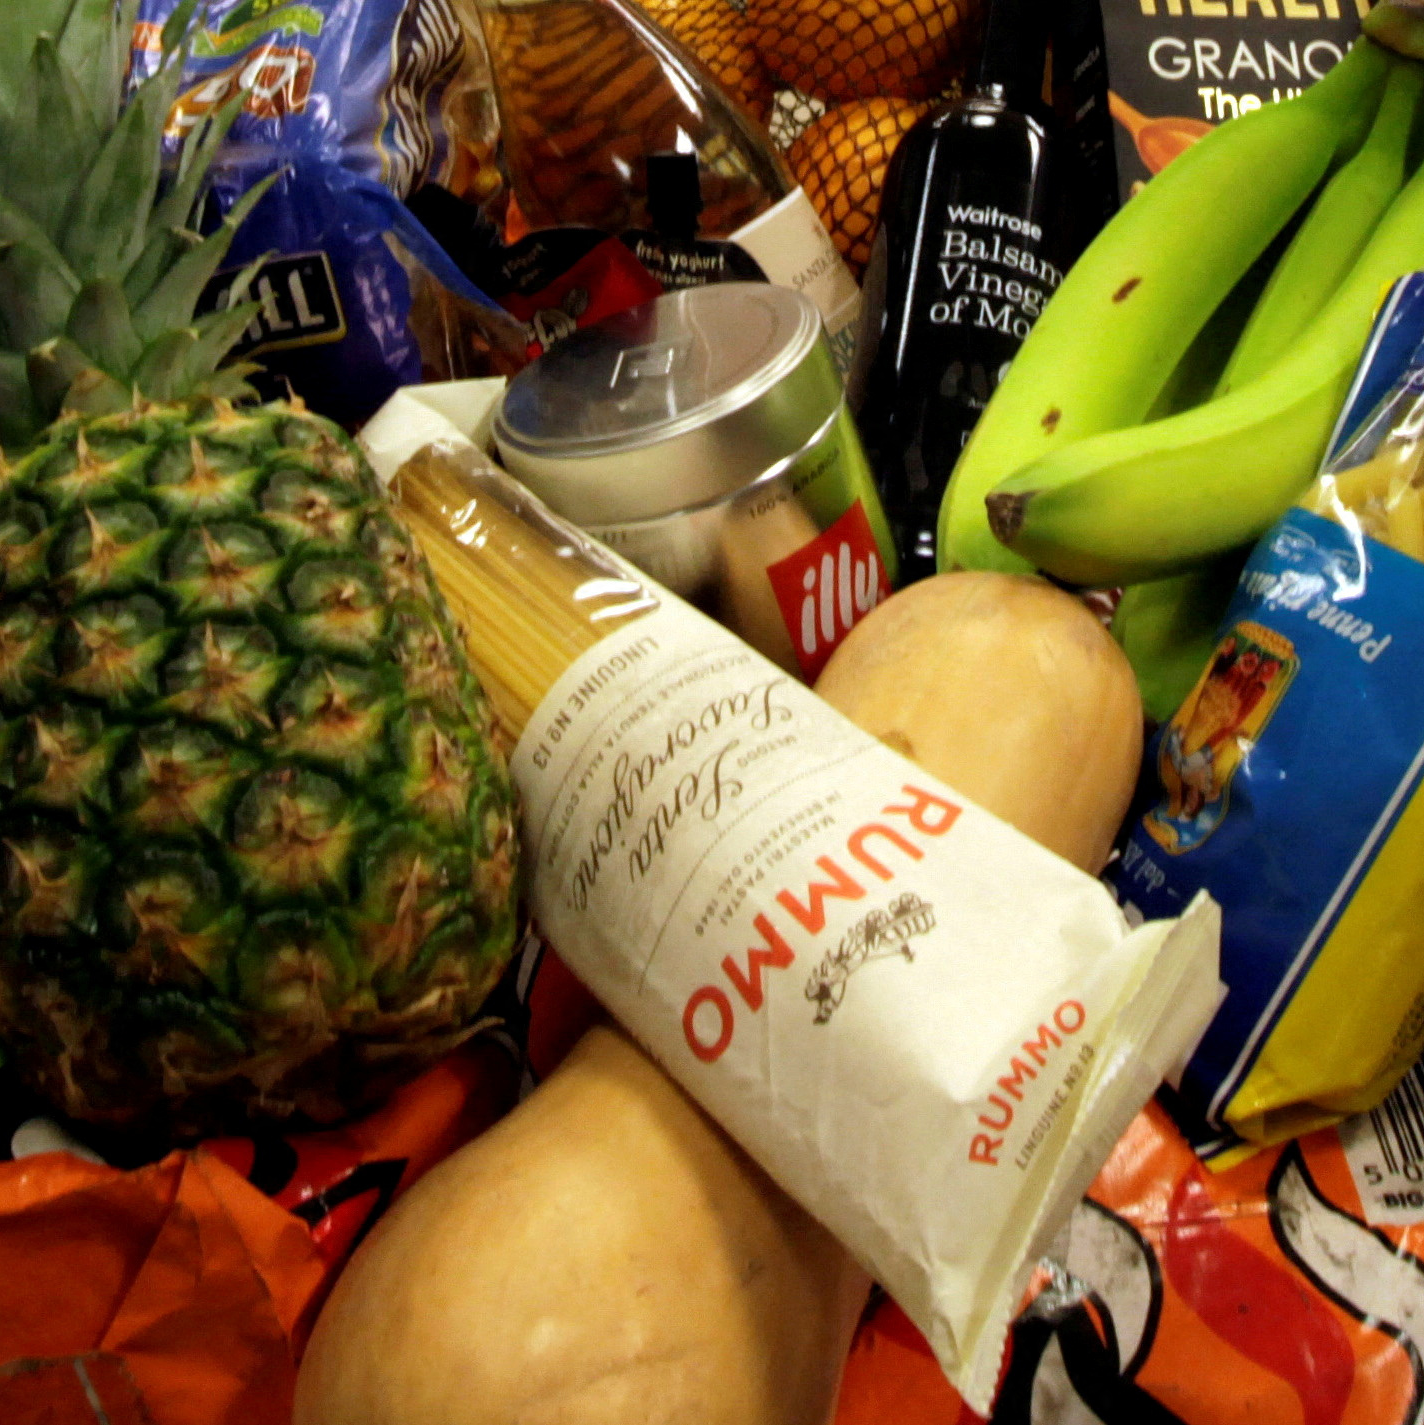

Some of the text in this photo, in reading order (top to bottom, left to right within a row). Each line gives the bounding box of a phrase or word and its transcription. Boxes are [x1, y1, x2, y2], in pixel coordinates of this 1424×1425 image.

[1148, 36, 1352, 80] GRANO
[1198, 86, 1262, 120] The
[947, 204, 1043, 243] Waitrose
[940, 228, 1064, 288] Balsam
[929, 294, 970, 324] of
[937, 260, 1047, 317] Vineg
[801, 541, 878, 655] illy
[1307, 599, 1393, 663] Penne
[568, 635, 660, 714] LINGUINE
[532, 741, 553, 772] 13
[628, 738, 744, 884] Lenta
[717, 865, 742, 895] DAL
[719, 867, 765, 926] PASTAI
[682, 783, 963, 1064] RUMMO
[968, 998, 1086, 1167] RUMMO
[1014, 1088, 1068, 1171] LINGUINE
[1364, 1163, 1383, 1185] 5
[1383, 1191, 1424, 1209] BIG
